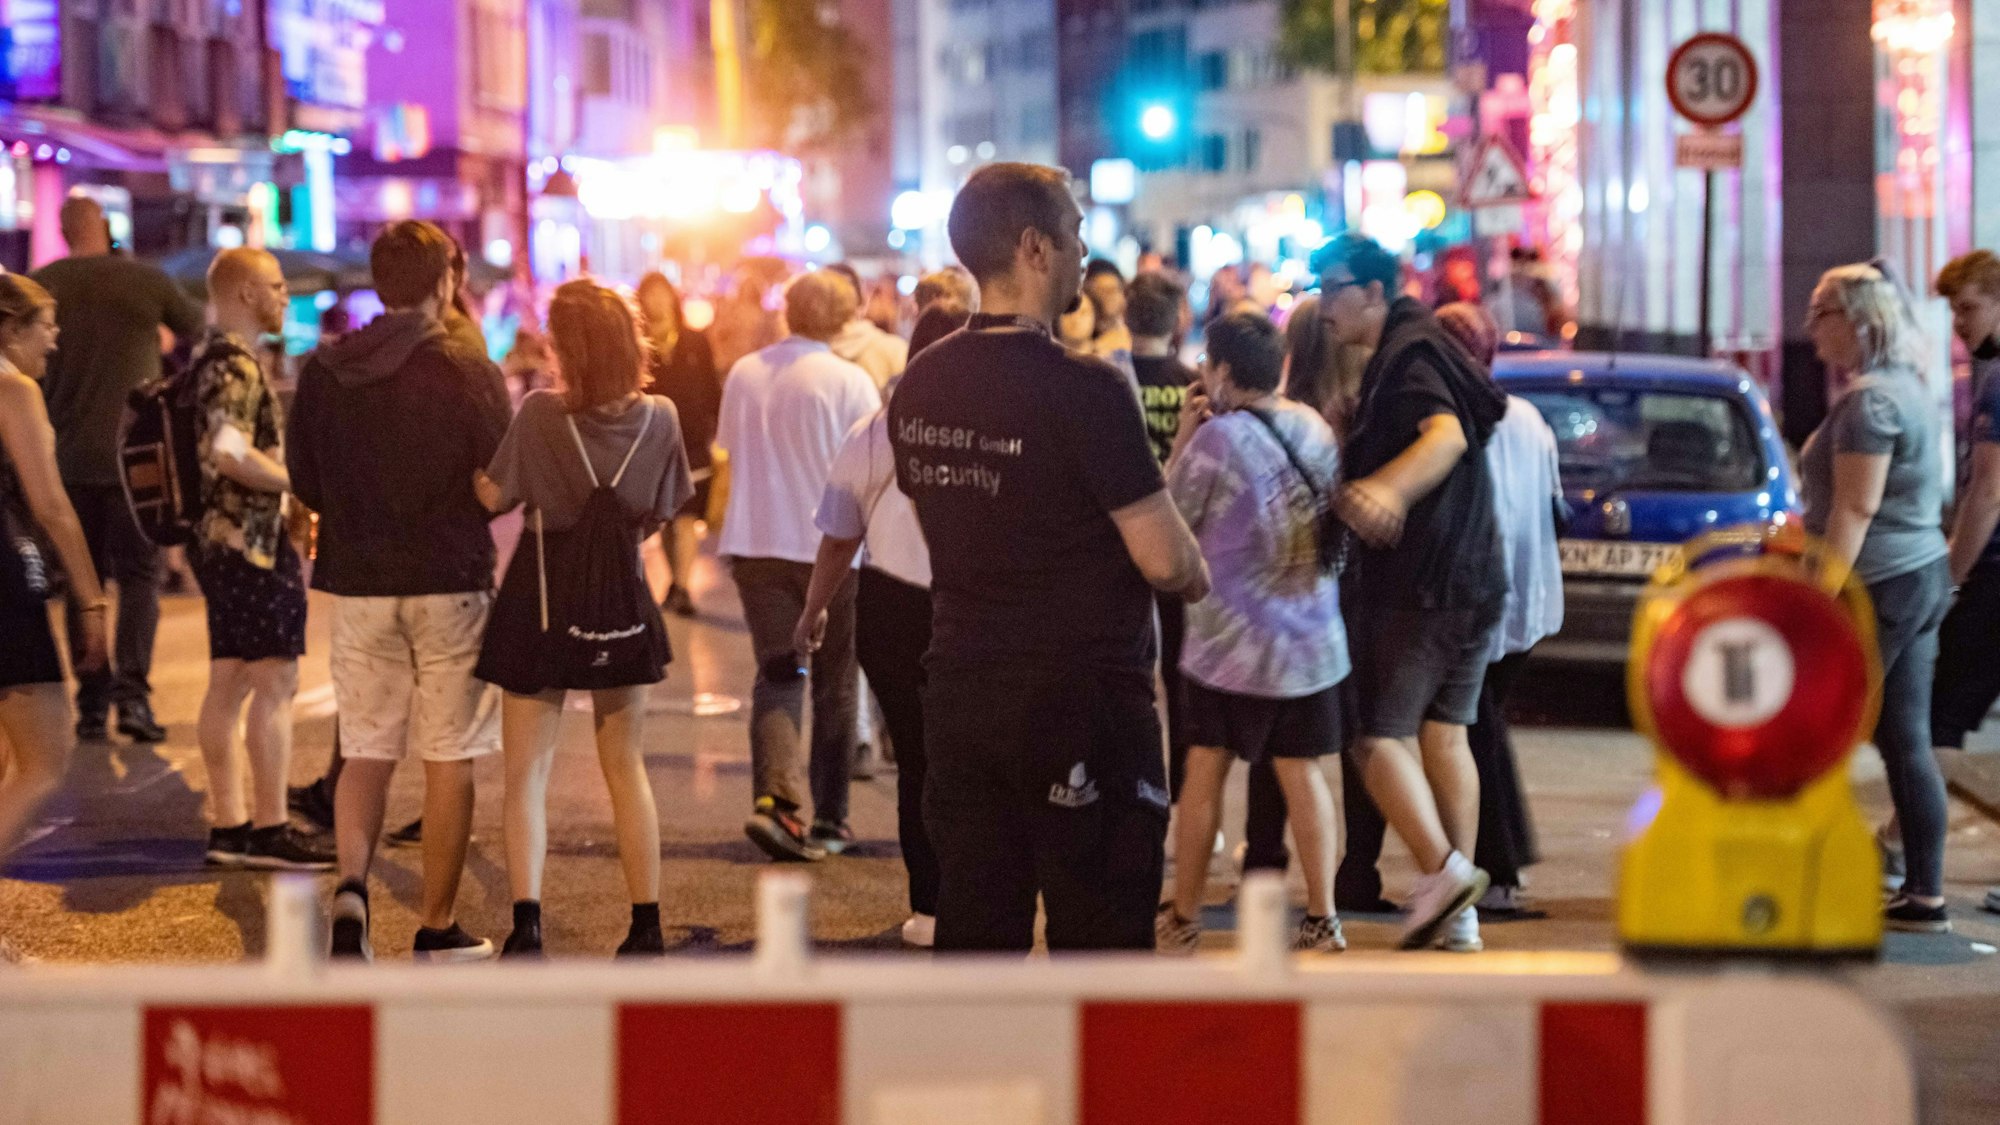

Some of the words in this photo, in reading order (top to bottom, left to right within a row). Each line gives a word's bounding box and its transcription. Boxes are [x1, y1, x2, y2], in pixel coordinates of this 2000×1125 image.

[1686, 57, 1740, 102] 30
[979, 436, 1023, 456] GmbH
[908, 457, 1000, 498] Security
